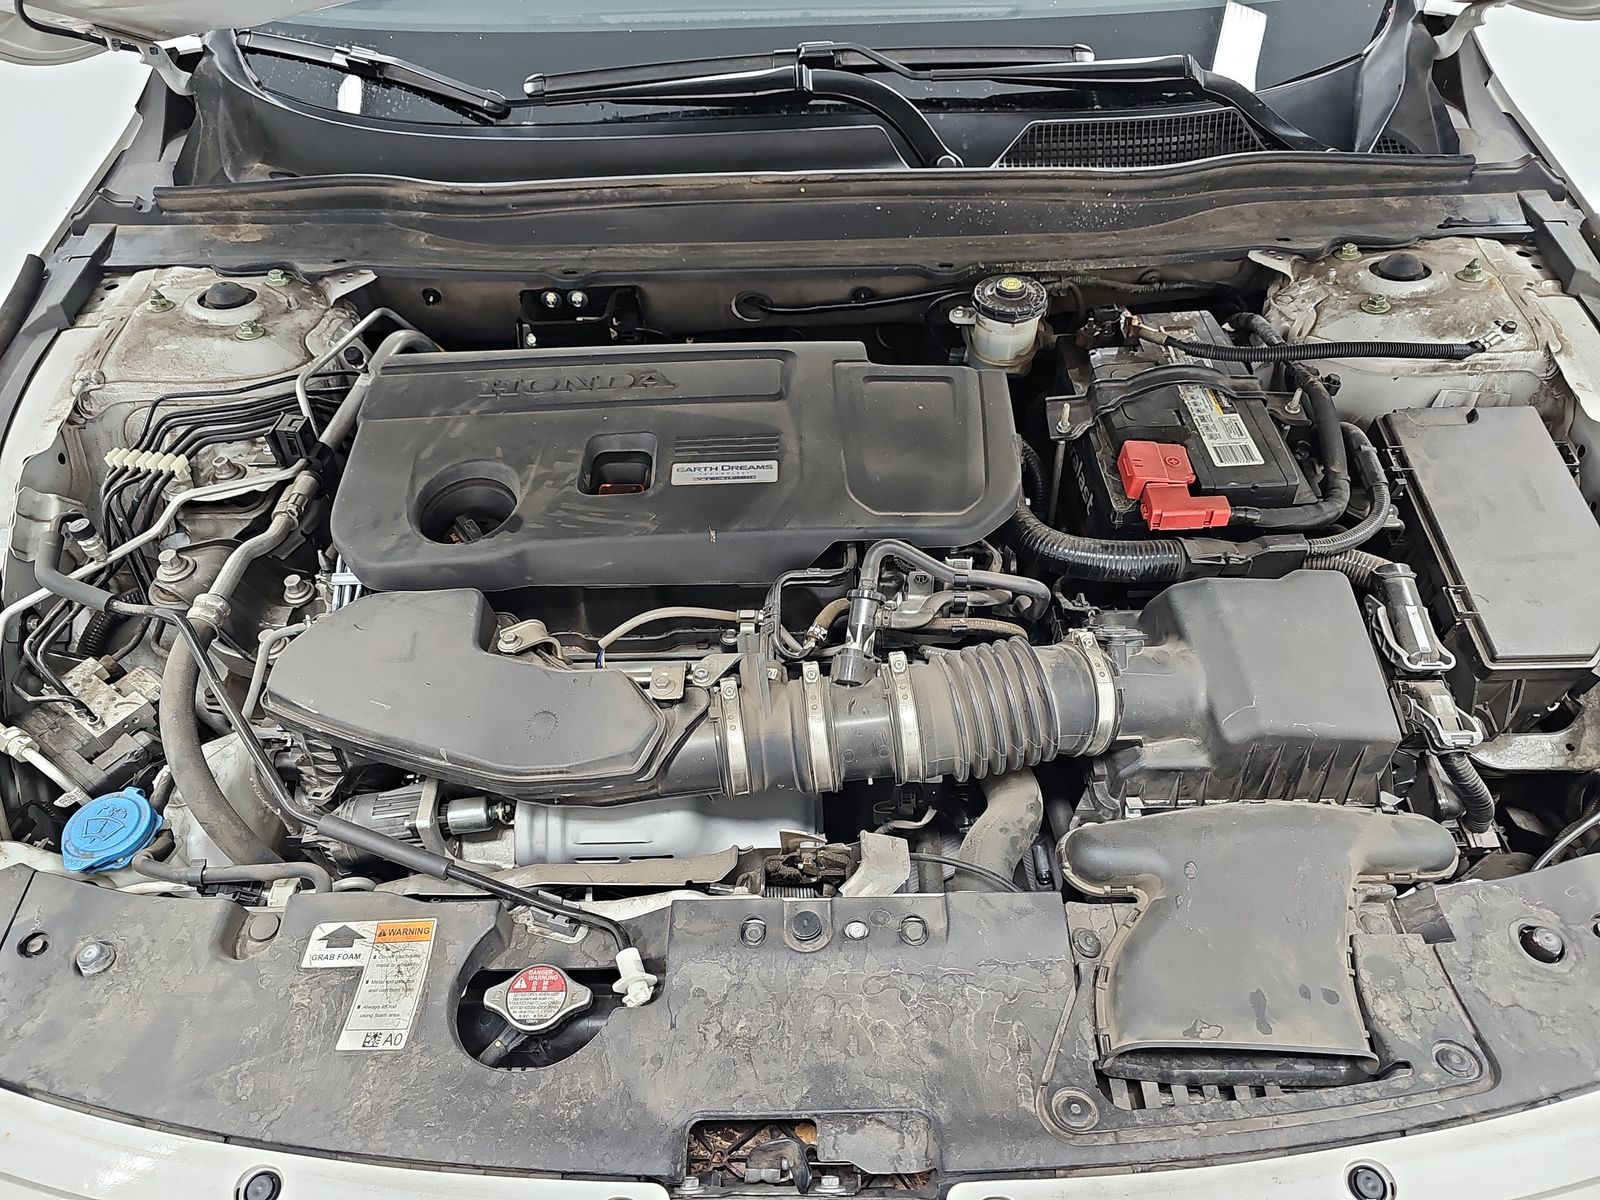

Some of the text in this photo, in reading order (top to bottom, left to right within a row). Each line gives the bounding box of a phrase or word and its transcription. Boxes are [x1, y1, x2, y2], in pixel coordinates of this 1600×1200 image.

[478, 370, 678, 398] HONDA
[388, 927, 430, 937] WARNING
[311, 953, 335, 961] GRAB
